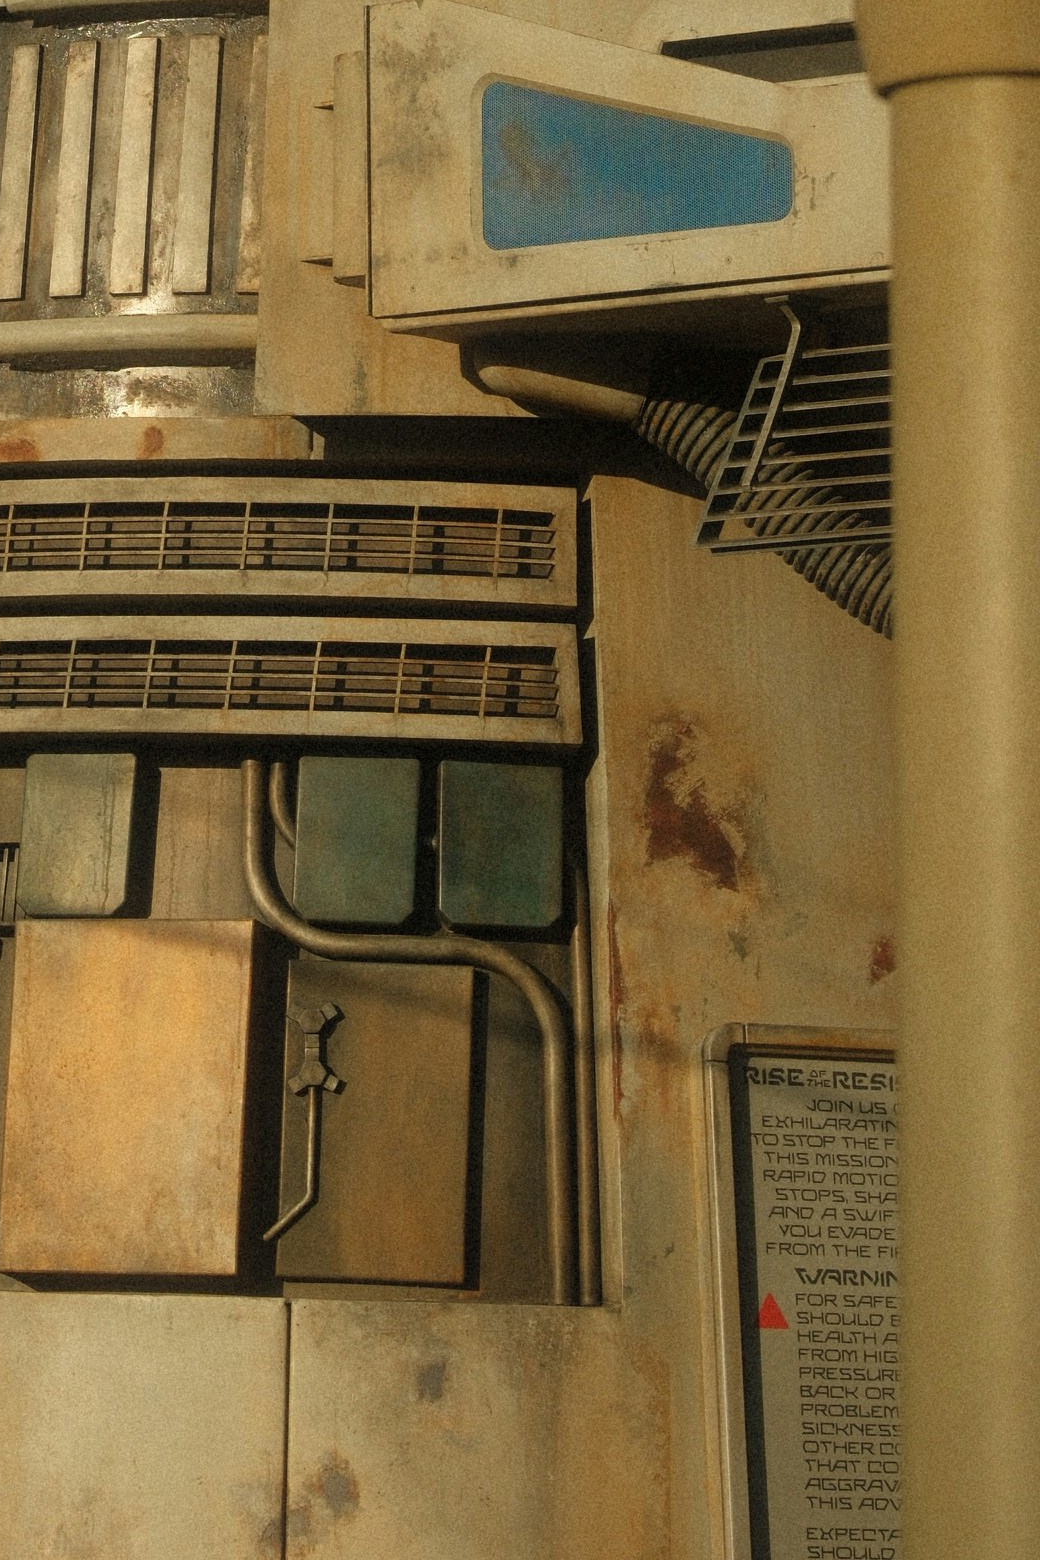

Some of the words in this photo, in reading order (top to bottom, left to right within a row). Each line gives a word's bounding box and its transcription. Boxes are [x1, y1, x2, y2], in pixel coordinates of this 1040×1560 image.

[747, 1066, 804, 1087] RISE
[810, 1069, 827, 1078] OF
[833, 1071, 895, 1091] RESI
[806, 1079, 832, 1088] THE
[806, 1099, 853, 1113] JOIN
[859, 1101, 887, 1115] US
[761, 1115, 897, 1132] EXHILARATIN
[751, 1133, 779, 1146] TO
[783, 1134, 836, 1148] STOP
[842, 1136, 879, 1150] THE
[884, 1138, 897, 1151] F
[764, 1151, 810, 1165] THIS
[763, 1170, 826, 1184] RAPID
[833, 1172, 900, 1187] MOTIO
[775, 1188, 848, 1204] STOPS,
[855, 1191, 898, 1205] SHA
[768, 1206, 814, 1219] AND
[821, 1208, 837, 1220] A
[843, 1208, 898, 1223] SWIF
[778, 1225, 822, 1238] YOU
[828, 1226, 896, 1240] EVADE
[766, 1242, 825, 1256] FROM
[831, 1244, 871, 1258] THE
[794, 1267, 898, 1287] WARNIN
[796, 1293, 838, 1307] FOR
[843, 1295, 898, 1309] SAFE
[797, 1311, 884, 1327] SHOULD
[797, 1330, 877, 1344] HEALTH
[883, 1332, 899, 1345] A
[799, 1348, 858, 1362] FROM
[864, 1350, 899, 1364] HIG
[800, 1385, 859, 1399] BACK
[865, 1387, 896, 1400] OR
[801, 1403, 899, 1418] PROBLEM
[802, 1422, 901, 1437] SICKNESS
[803, 1440, 875, 1455] OTHER
[804, 1459, 861, 1473] THAT
[868, 1461, 900, 1474] CO
[804, 1477, 900, 1492] AGGRAV
[805, 1496, 853, 1509] THIS
[858, 1497, 900, 1511] ADV
[806, 1527, 901, 1542] EXPECTA
[807, 1546, 896, 1560] SHOULD
